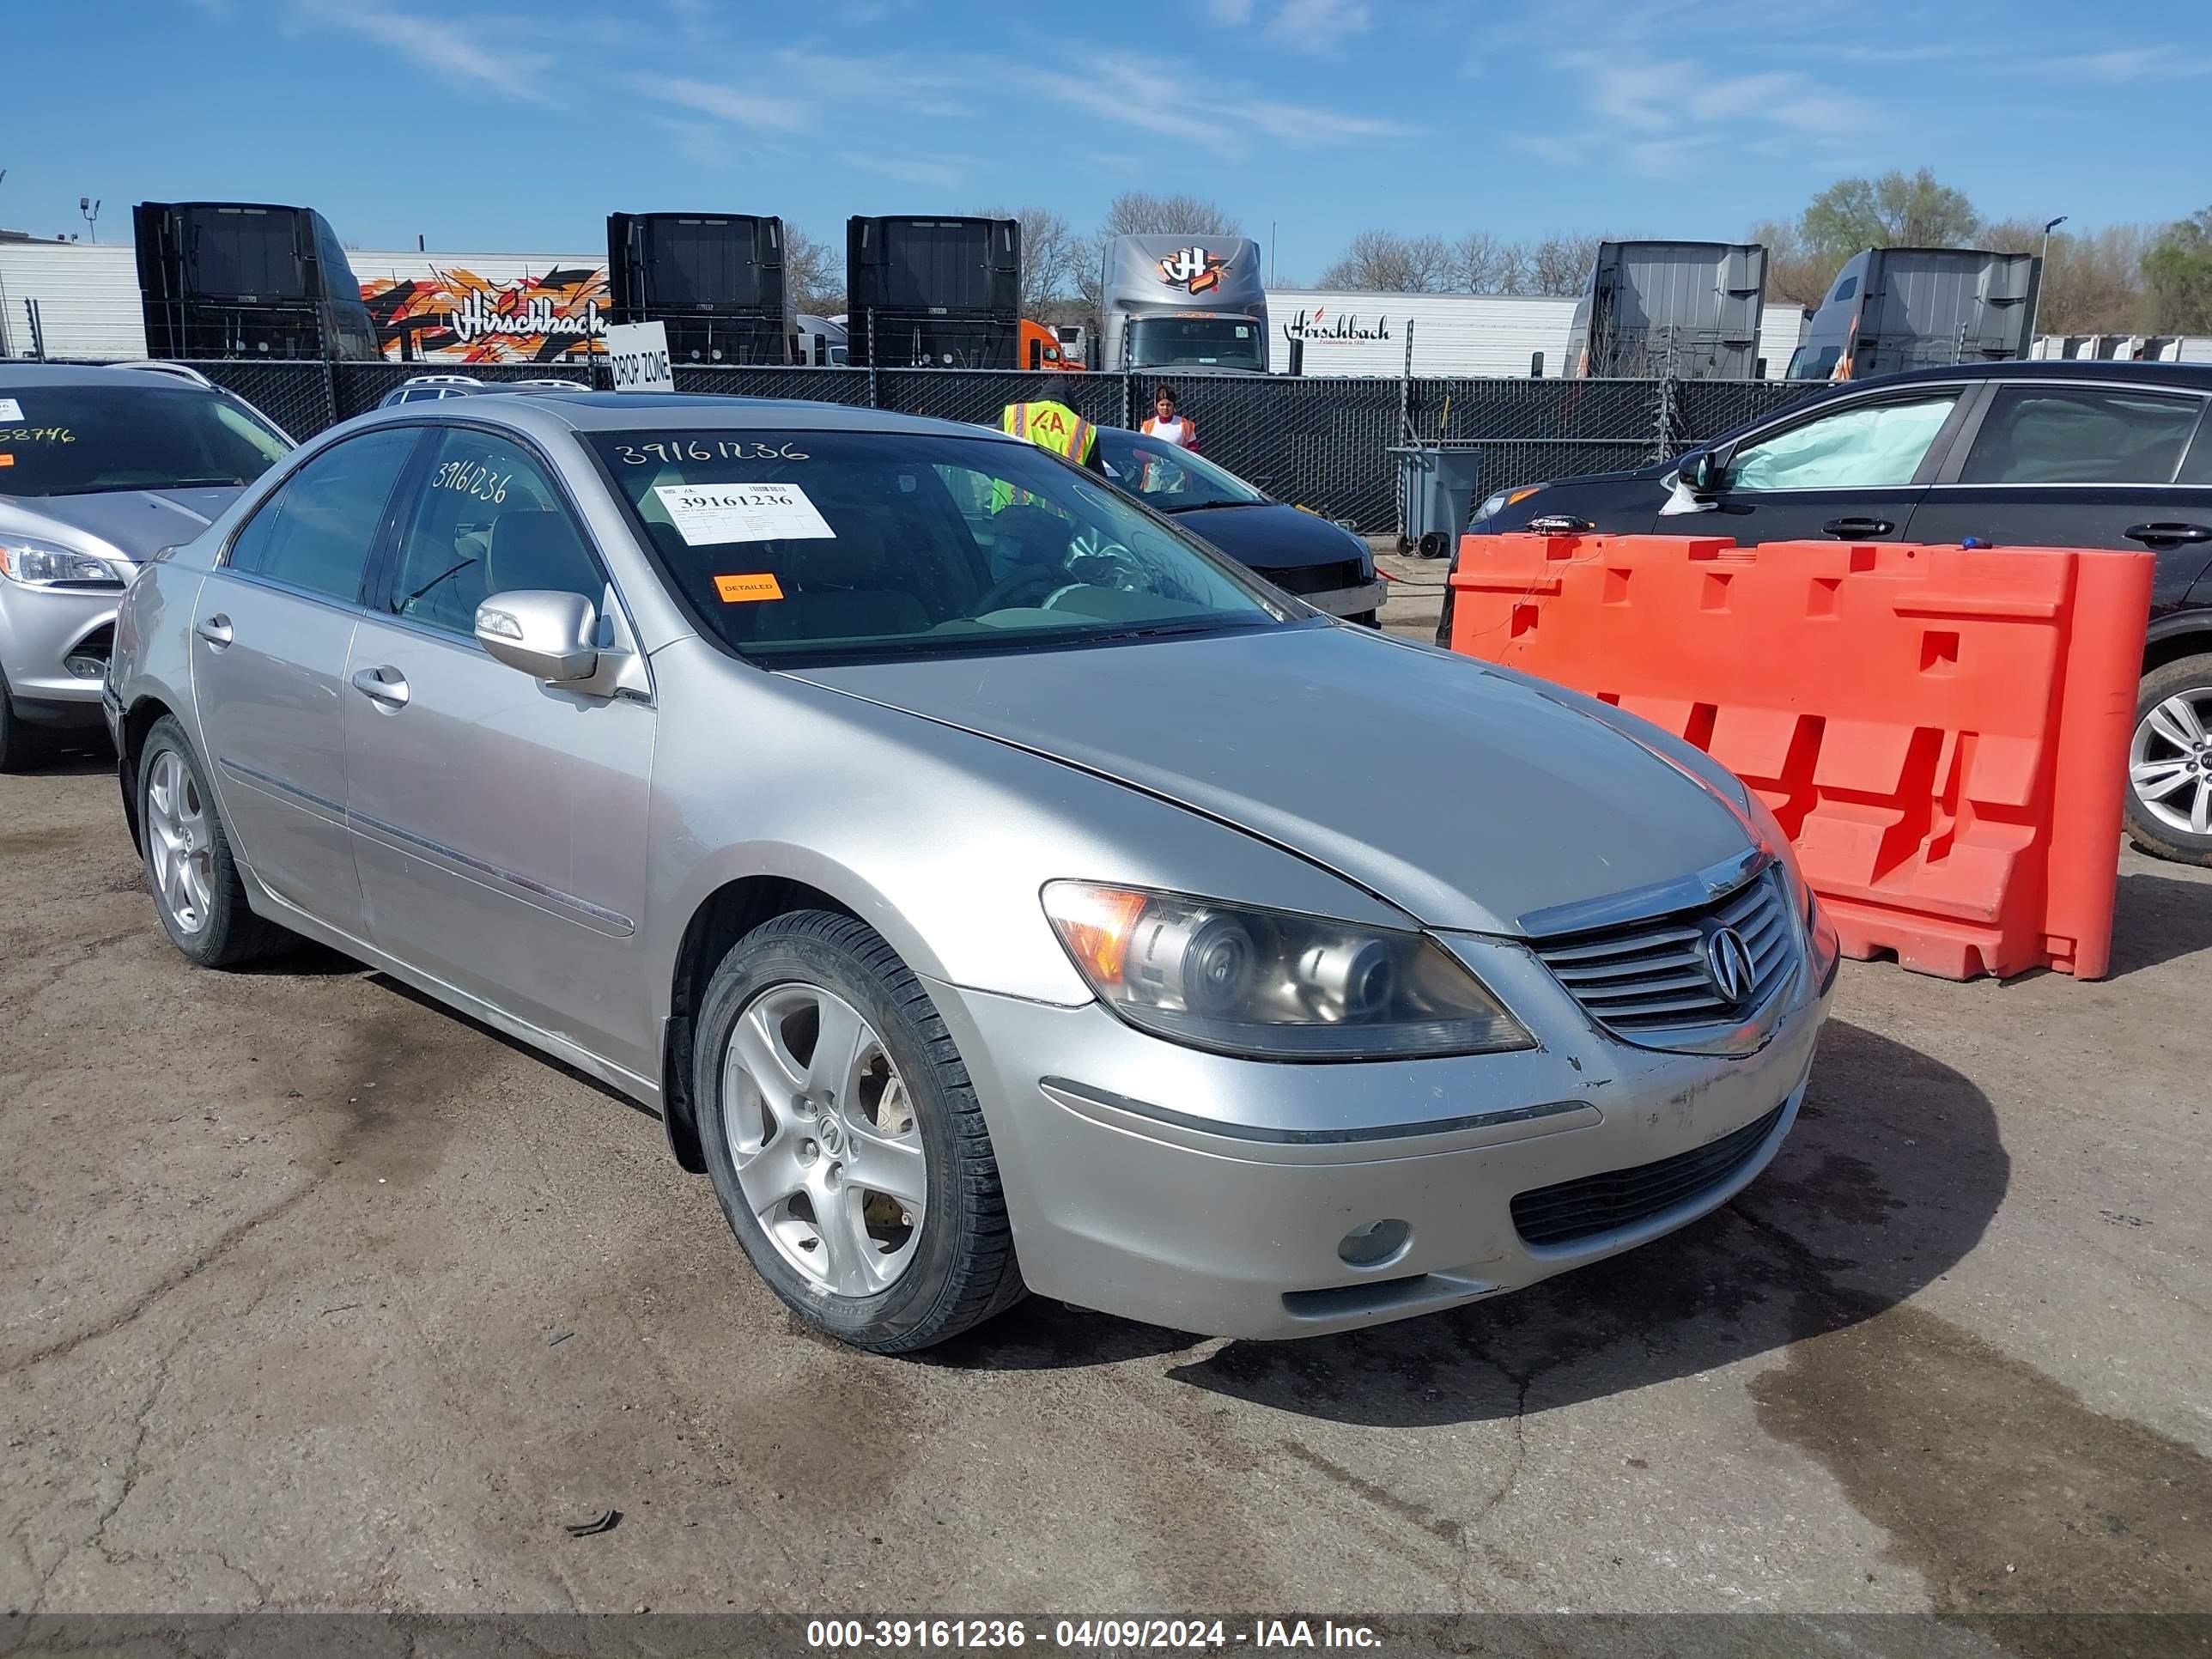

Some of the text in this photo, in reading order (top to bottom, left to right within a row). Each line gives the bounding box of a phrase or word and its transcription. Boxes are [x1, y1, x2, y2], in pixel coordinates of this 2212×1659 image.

[452, 288, 612, 342] Hirschbach
[1284, 309, 1393, 341] Hirschbach
[611, 350, 671, 386] DROP ZONE
[615, 440, 811, 465] 39161236
[432, 459, 514, 504] 39161236
[678, 494, 794, 509] 39161236
